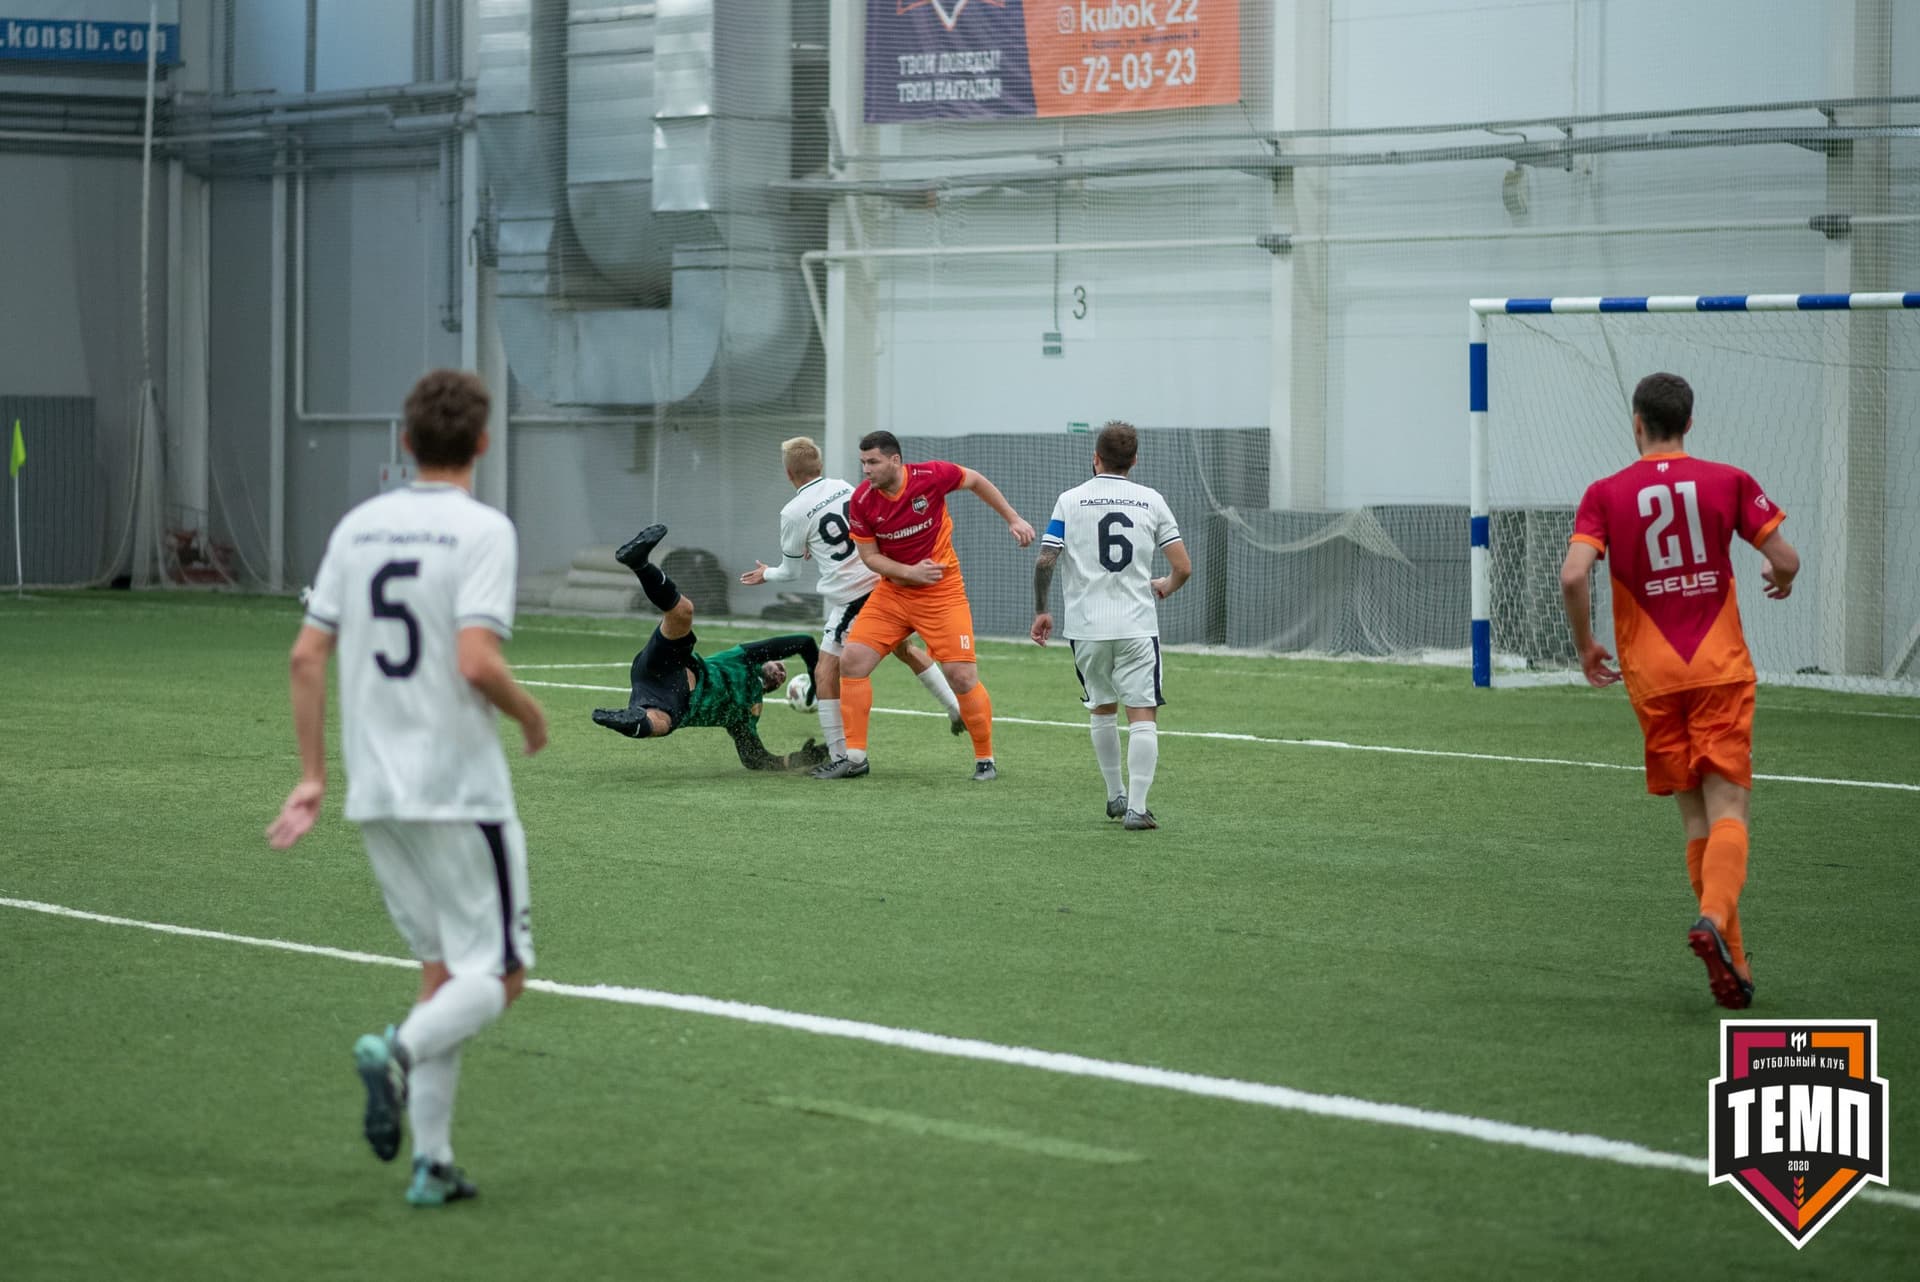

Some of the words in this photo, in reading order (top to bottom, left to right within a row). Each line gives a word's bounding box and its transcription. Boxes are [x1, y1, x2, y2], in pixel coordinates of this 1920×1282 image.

[897, 54, 936, 75] ТВОИ
[1082, 48, 1197, 93] 72-03-23
[897, 81, 933, 102] ТВОИ
[1073, 285, 1087, 320] 3
[818, 501, 855, 562] 9
[1098, 511, 1134, 573] 6
[1637, 480, 1707, 571] 21
[1645, 571, 1717, 596] SEUS
[370, 559, 421, 678] 5
[959, 634, 970, 650] 13
